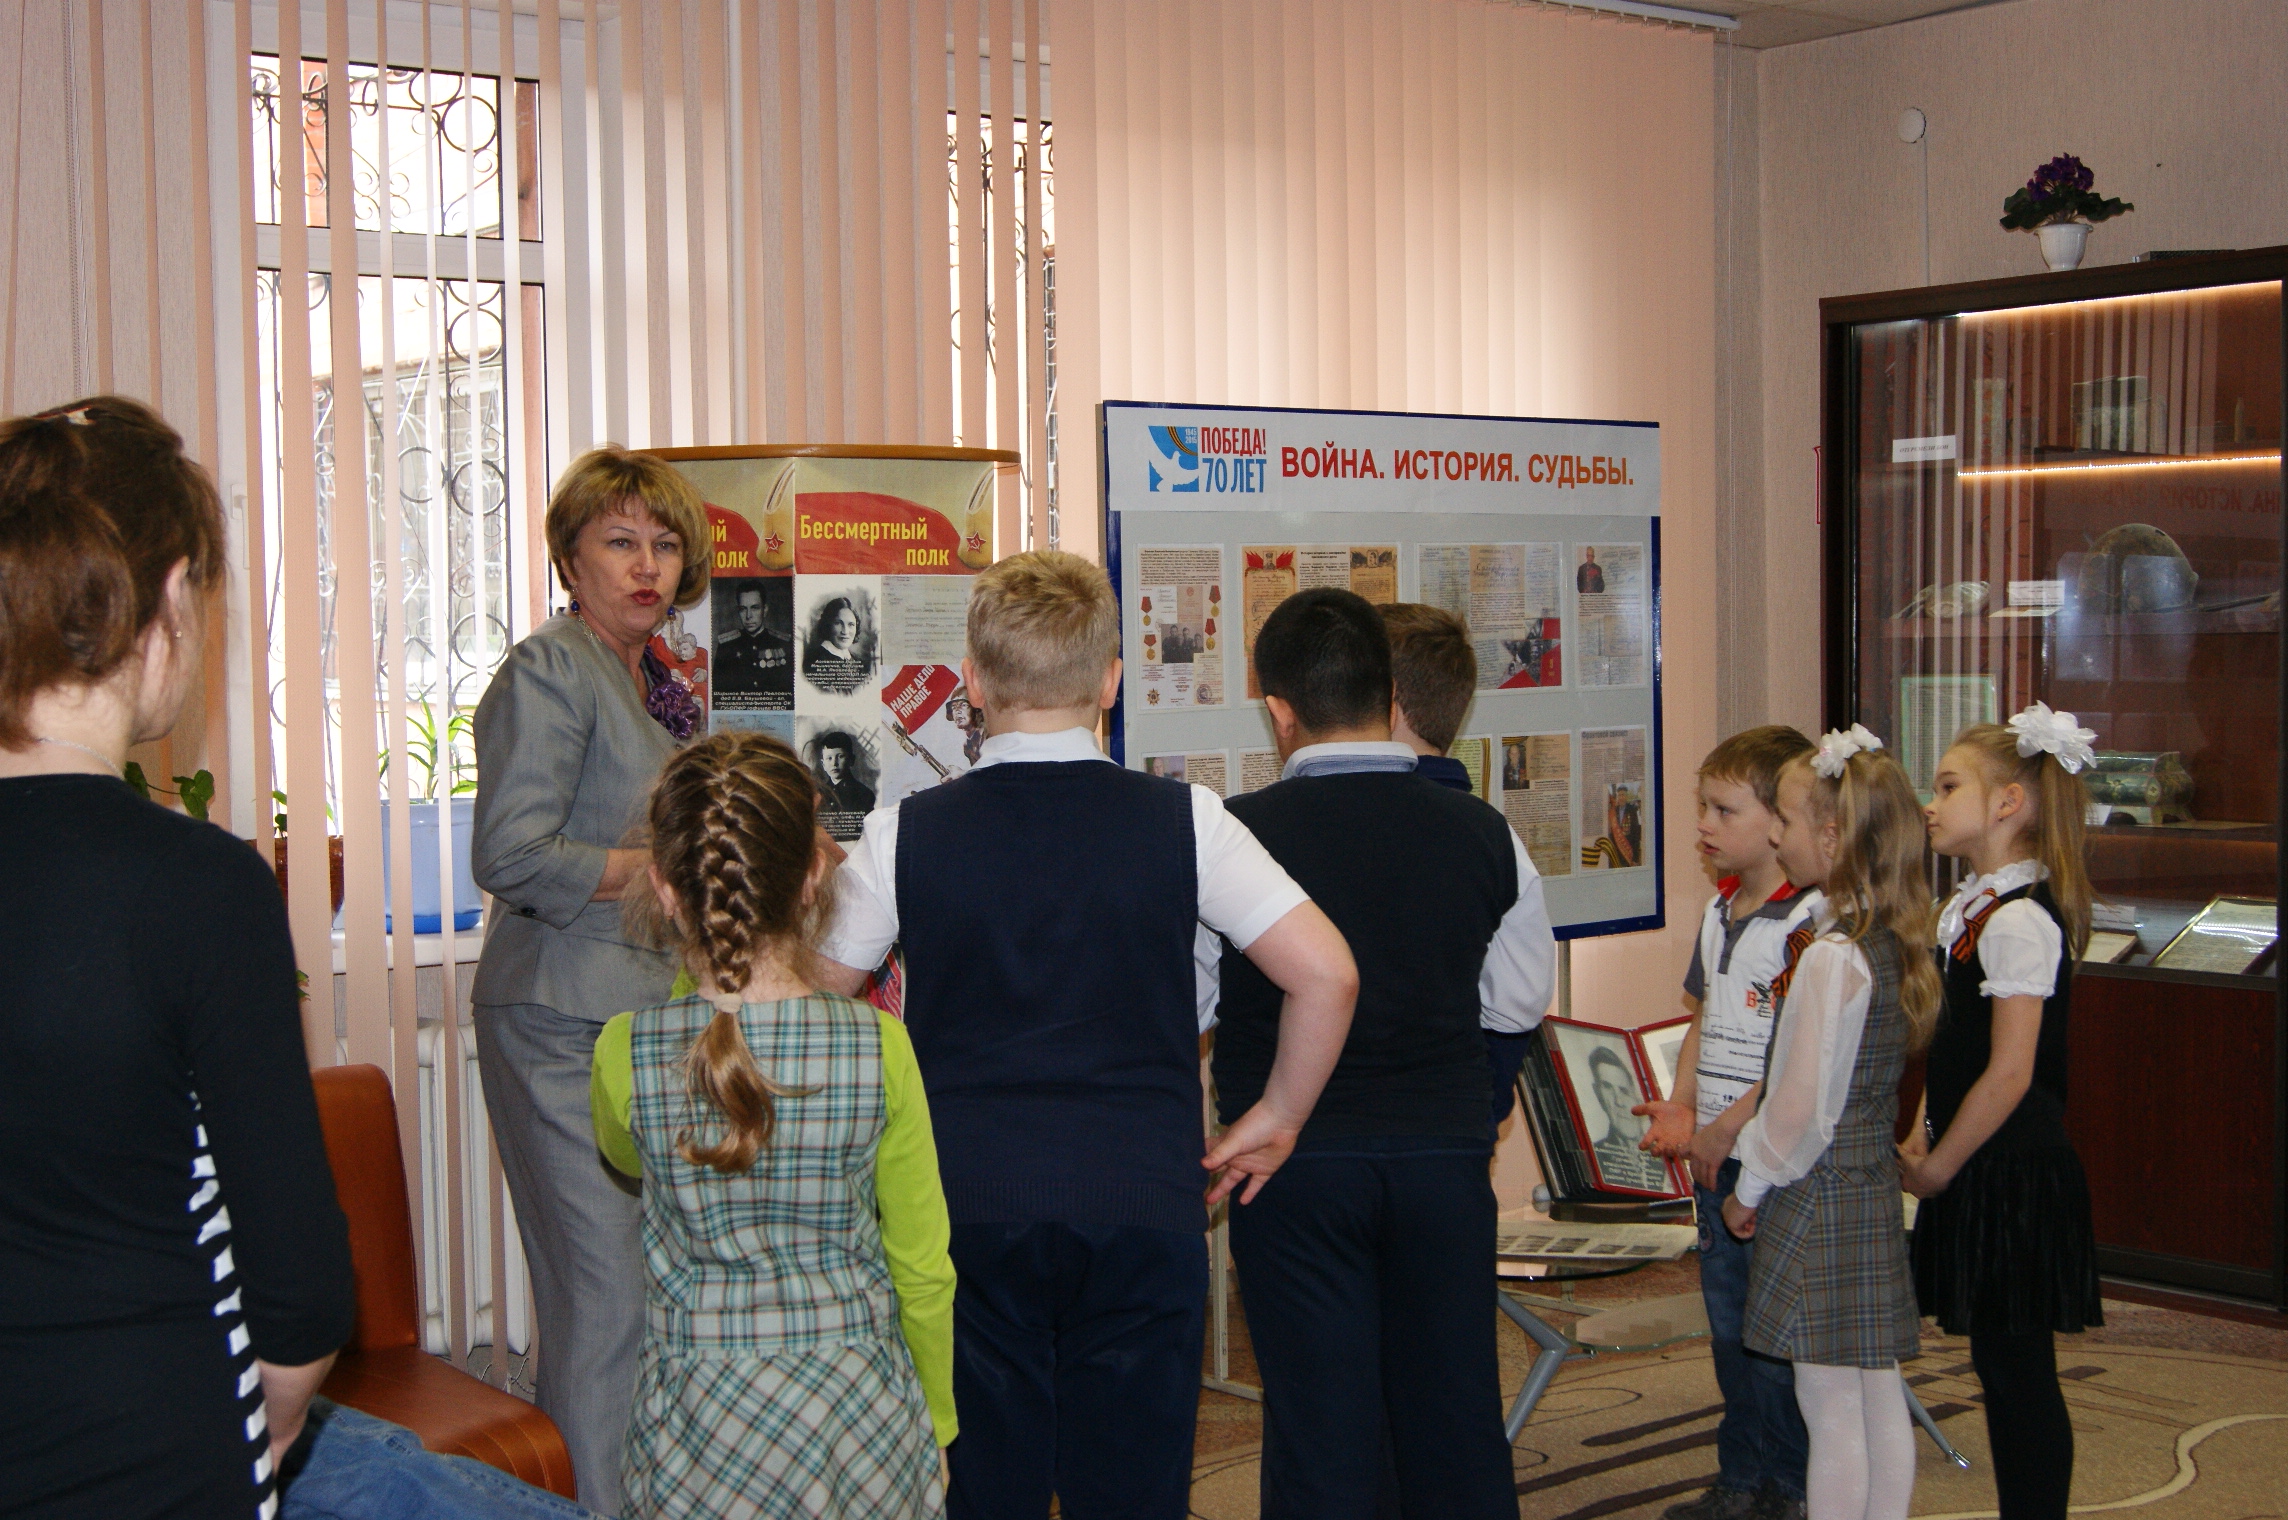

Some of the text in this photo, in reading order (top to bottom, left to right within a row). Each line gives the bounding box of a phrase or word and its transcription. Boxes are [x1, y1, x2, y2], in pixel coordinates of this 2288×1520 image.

[1185, 428, 1197, 436] 1945
[1185, 436, 1198, 444] 2015
[1201, 427, 1266, 456] ПОБЕДА!
[1202, 458, 1267, 493] 70 ЛЕТ
[1282, 440, 1634, 489] ВОЙНА. ИСТОРИЯ. СУДЬБЫ.
[800, 514, 928, 546] Бессмертный
[906, 550, 950, 566] полк
[890, 665, 936, 712] НАШЕ ДЕЛО
[900, 685, 932, 718] ПРАВОЕ
